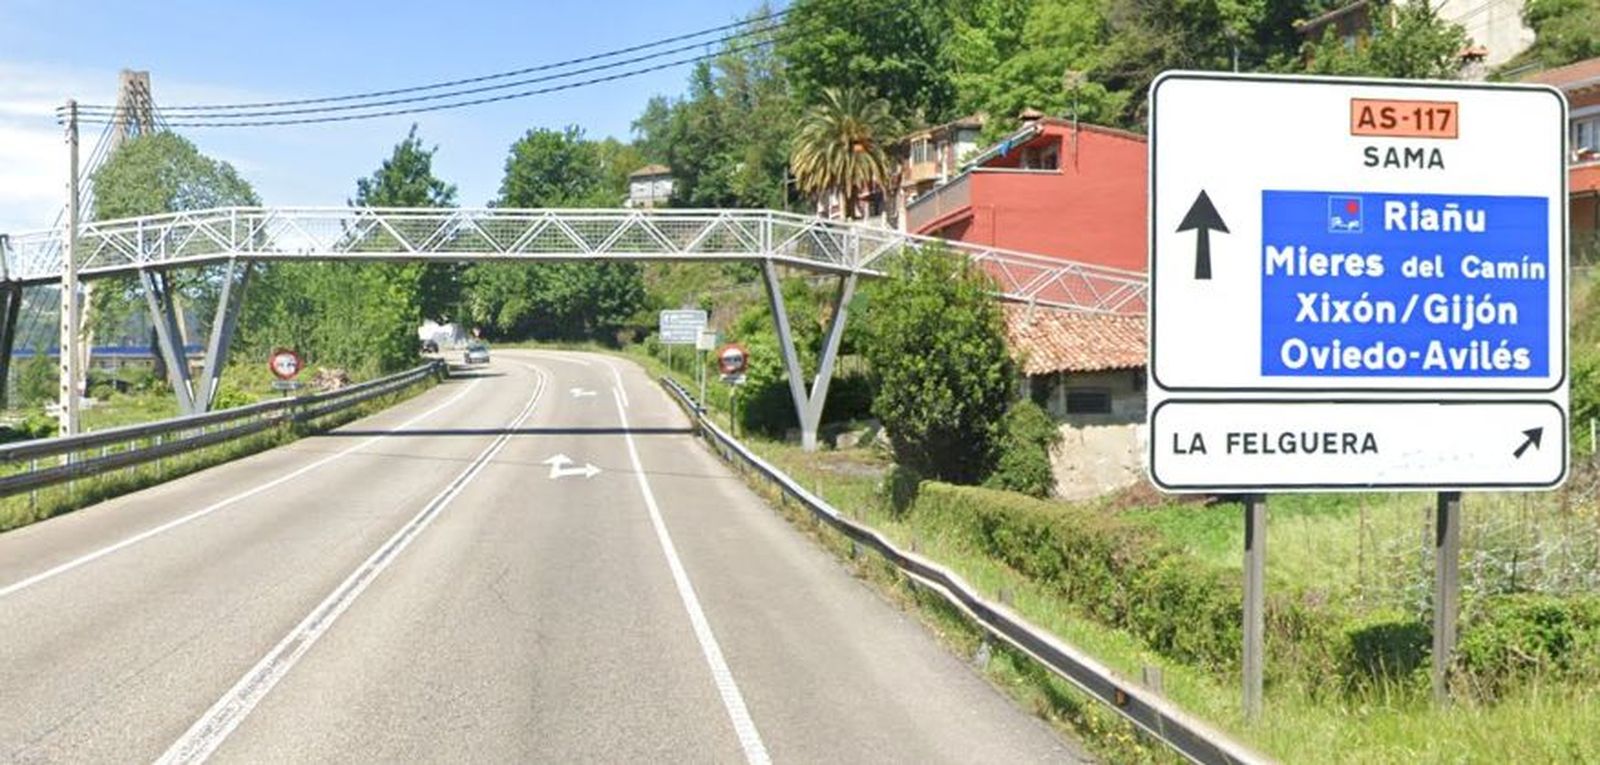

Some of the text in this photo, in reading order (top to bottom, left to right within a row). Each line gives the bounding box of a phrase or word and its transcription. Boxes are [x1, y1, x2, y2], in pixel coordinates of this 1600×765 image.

[1358, 106, 1451, 130] AS-117
[1364, 146, 1446, 169] SAMA
[1384, 200, 1486, 233] Riañu
[1265, 244, 1546, 280] Mieres del Camín
[1295, 291, 1518, 332] Xixón/Gijón
[1280, 337, 1532, 371] Oviedo-Avilés
[1173, 431, 1379, 455] LA FELGUERA
